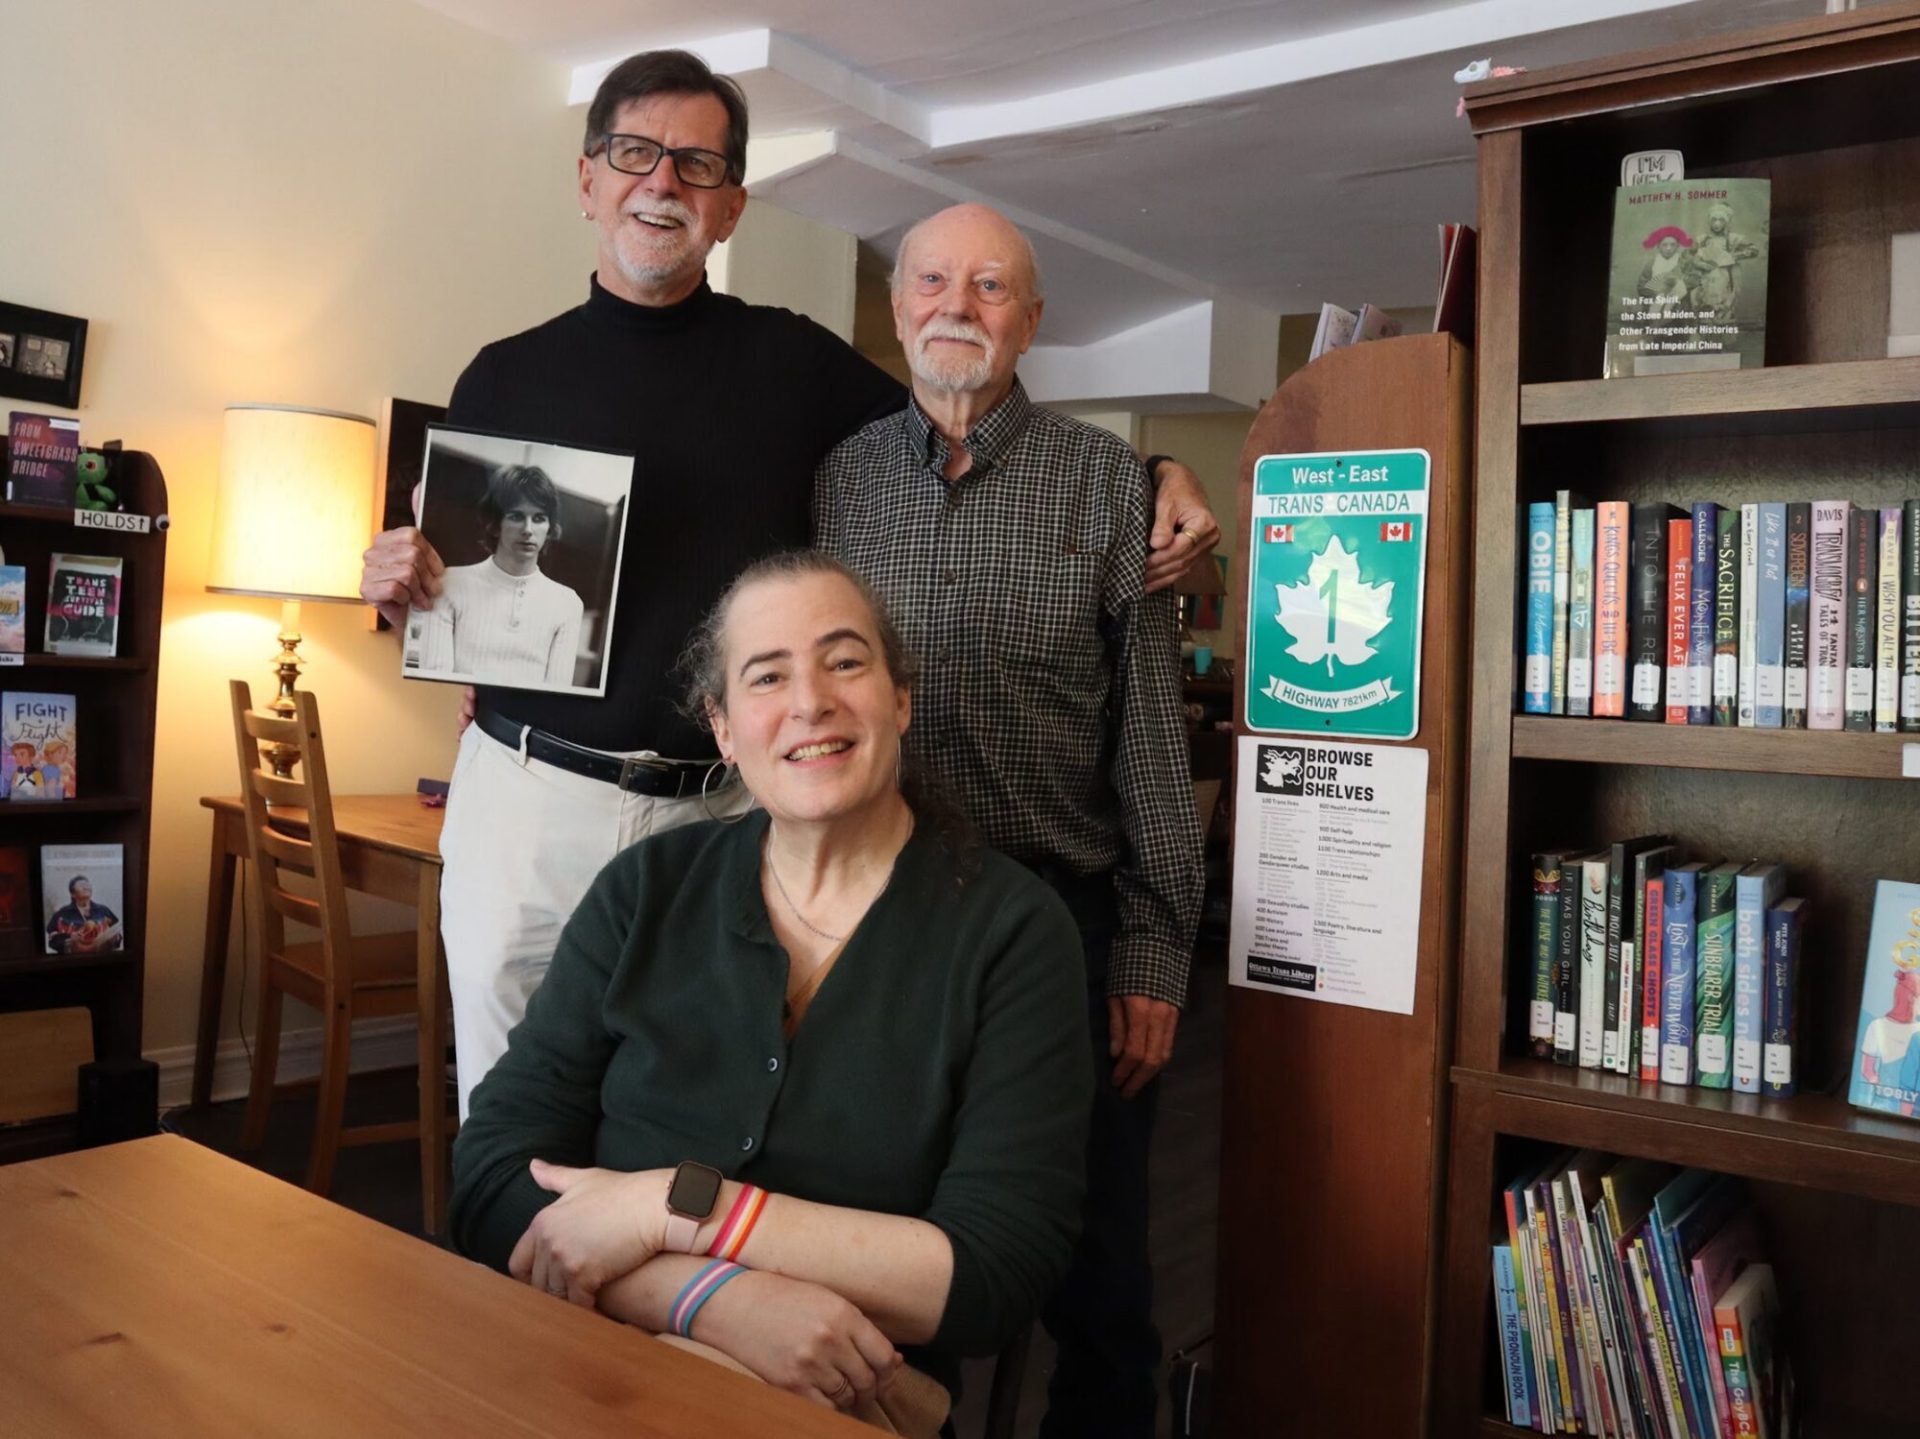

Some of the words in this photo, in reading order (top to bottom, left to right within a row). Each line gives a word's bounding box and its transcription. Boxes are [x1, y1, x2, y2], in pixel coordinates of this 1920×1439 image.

[1638, 155, 1665, 173] I'M
[1629, 192, 1672, 205] MATTHEW
[1687, 190, 1728, 200] SOMMER
[1622, 297, 1637, 305] The
[1639, 296, 1653, 305] Fox
[1621, 312, 1635, 321] the
[1637, 311, 1661, 320] Stone
[1663, 310, 1697, 320] Maiden,
[1699, 310, 1715, 318] and
[1620, 327, 1643, 336] Other
[1645, 326, 1698, 336] Transgender
[1699, 325, 1739, 334] Histories
[1618, 342, 1638, 351] from
[1640, 342, 1659, 350] Late
[1661, 341, 1697, 351] Imperial
[1698, 341, 1723, 350] China
[13, 422, 42, 438] FROM
[13, 441, 78, 462] SWEETGRASS
[12, 460, 48, 477] BRIDGE
[1292, 467, 1334, 484] West
[1350, 465, 1389, 483] East
[1268, 496, 1324, 514] TRANS
[1336, 493, 1410, 512] CANADA
[1816, 509, 1843, 521] DAVIS
[80, 512, 138, 530] HOLDS
[1697, 511, 1707, 562] CALLENDER
[1531, 531, 1551, 594] OBIE
[1644, 530, 1659, 577] INTO
[1790, 533, 1805, 587] SOVEREIGN
[66, 576, 106, 587] TRANS
[66, 586, 106, 598] TEEN
[1674, 564, 1686, 600] FELIX
[1717, 549, 1735, 640] SACRIFICE
[1883, 581, 1895, 606] WISH
[63, 604, 104, 617] GUIDE
[1319, 569, 1339, 643] 1
[1819, 604, 1829, 628] TALES
[1674, 605, 1685, 640] EVER
[1882, 606, 1895, 633] YOU
[1819, 631, 1828, 642] OF
[1882, 635, 1895, 655] ALL
[1673, 645, 1686, 668] AFT
[1282, 686, 1339, 709] HIGHWAY
[16, 703, 68, 721] FIGHT
[9, 722, 67, 751] Flight
[1306, 749, 1373, 767] BROWSE
[1306, 766, 1337, 781] OUR
[1305, 783, 1374, 801] SHELVES
[1566, 872, 1573, 881] IF
[1564, 896, 1573, 919] WAS
[1611, 894, 1621, 910] THE
[1649, 890, 1658, 927] GREEN
[1562, 924, 1572, 955] YOUR
[1583, 898, 1605, 968] Birthday
[1667, 922, 1688, 947] LOST
[1737, 909, 1759, 960] both
[1648, 931, 1657, 966] GLASS
[1561, 960, 1571, 986] GIRL
[1704, 934, 1725, 998] SUNBEARER
[1647, 970, 1656, 1018] GHOSTS
[1667, 971, 1689, 1010] NEVER
[1737, 964, 1757, 1016] sides
[1703, 1003, 1722, 1034] TRIAL
[1875, 1084, 1918, 1102] TOBLY
[1507, 1313, 1517, 1332] THE
[1508, 1332, 1522, 1375] PRONOUN
[1729, 1362, 1740, 1384] The
[1513, 1376, 1525, 1400] BOOK
[1734, 1387, 1750, 1437] GayBCs
